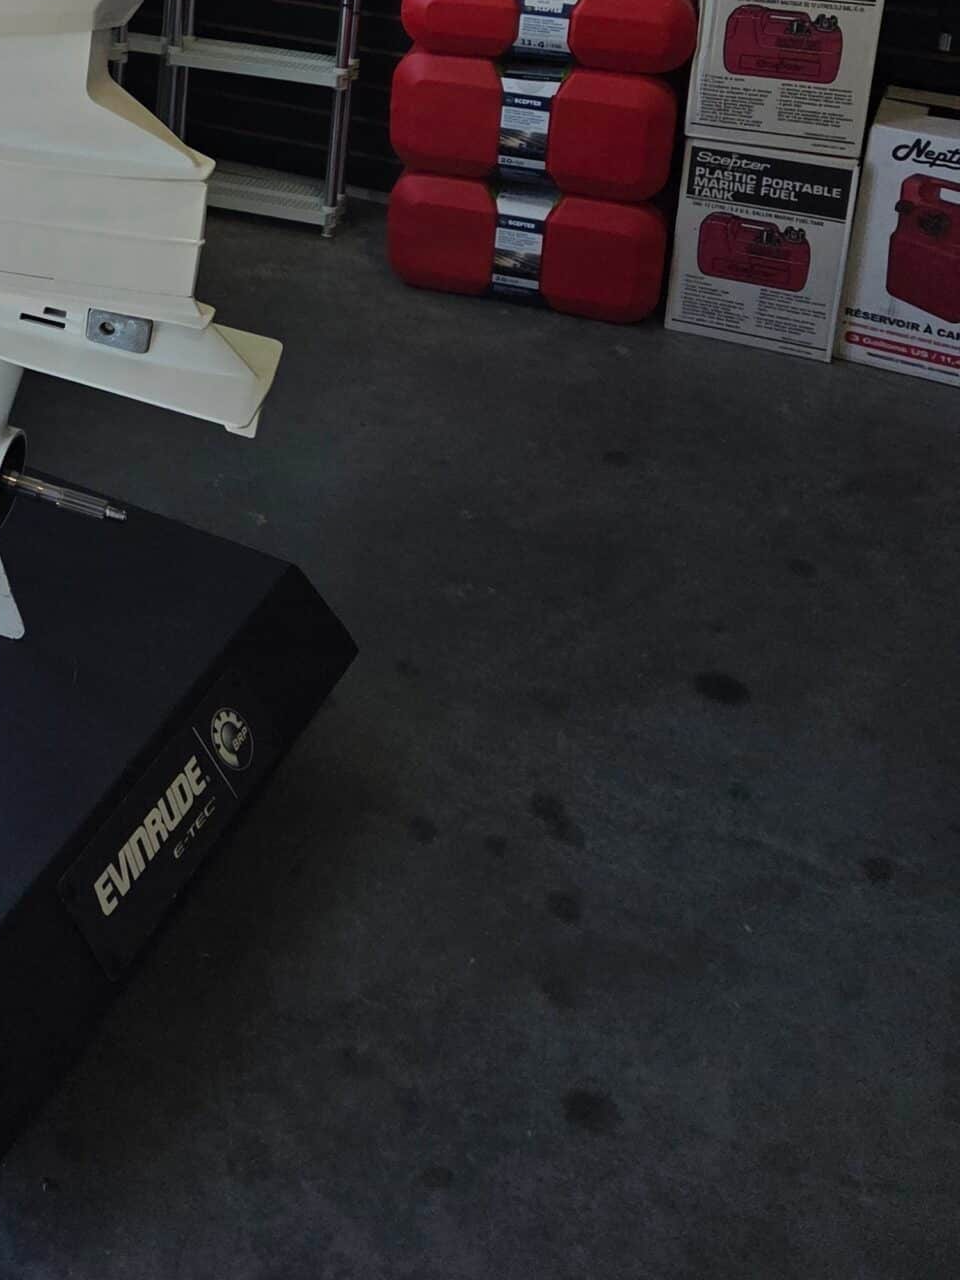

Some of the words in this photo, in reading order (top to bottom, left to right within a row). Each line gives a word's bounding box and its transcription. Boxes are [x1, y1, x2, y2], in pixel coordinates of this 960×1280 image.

[696, 150, 772, 170] Scepter
[892, 138, 960, 167] Nept
[693, 185, 735, 201] TANK
[694, 176, 755, 195] MARINE
[760, 186, 799, 202] FUEL
[695, 166, 757, 185] PLASTIC
[761, 176, 842, 199] PORTABLE
[845, 307, 920, 332] RÉSERVOIR
[923, 323, 933, 335] À
[910, 346, 928, 358] US
[232, 726, 248, 751] BRP
[93, 755, 207, 917] EVINRUDE
[173, 801, 216, 859] E-TEC
